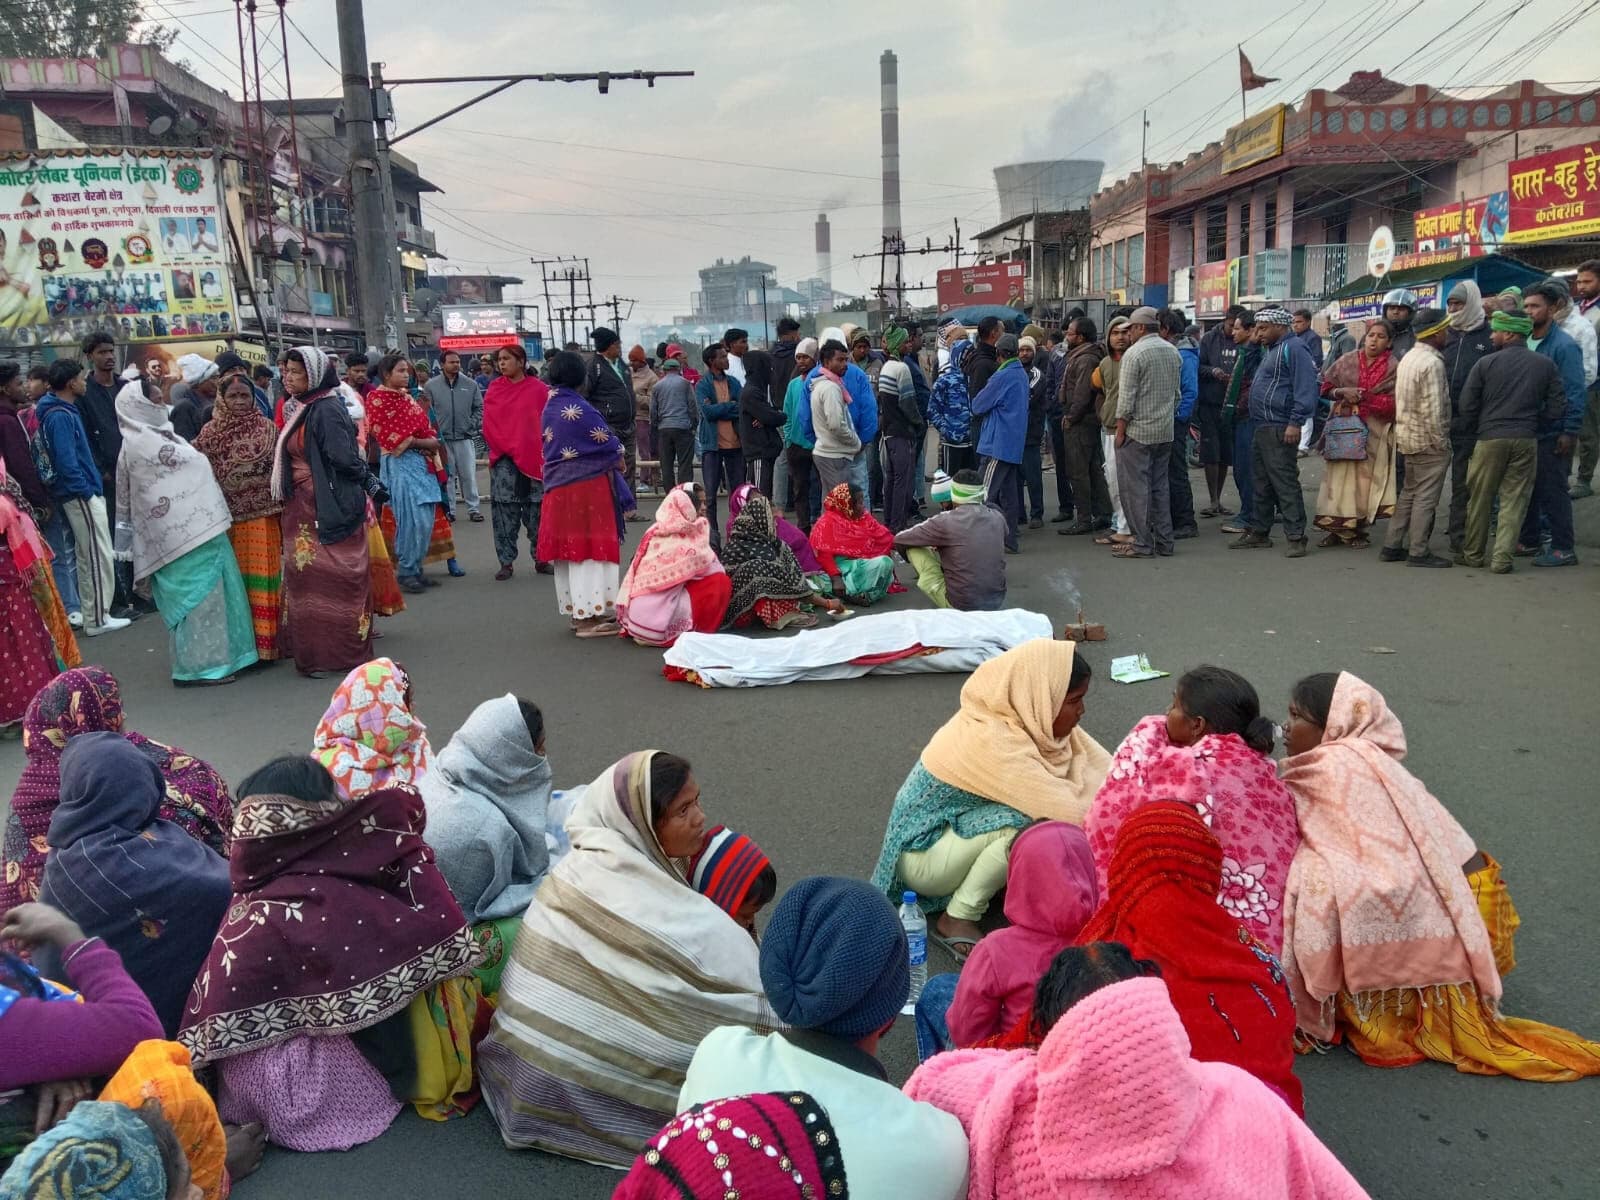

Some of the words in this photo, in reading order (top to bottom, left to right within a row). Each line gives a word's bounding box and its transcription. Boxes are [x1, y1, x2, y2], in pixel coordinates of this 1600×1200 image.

[36, 165, 69, 184] लेबर
[72, 163, 122, 187] यूनियन
[1512, 160, 1580, 201] सास-बहु
[1583, 146, 1600, 192] ड्रे
[52, 192, 80, 203] कथारा
[216, 344, 267, 361] DIECTOR
